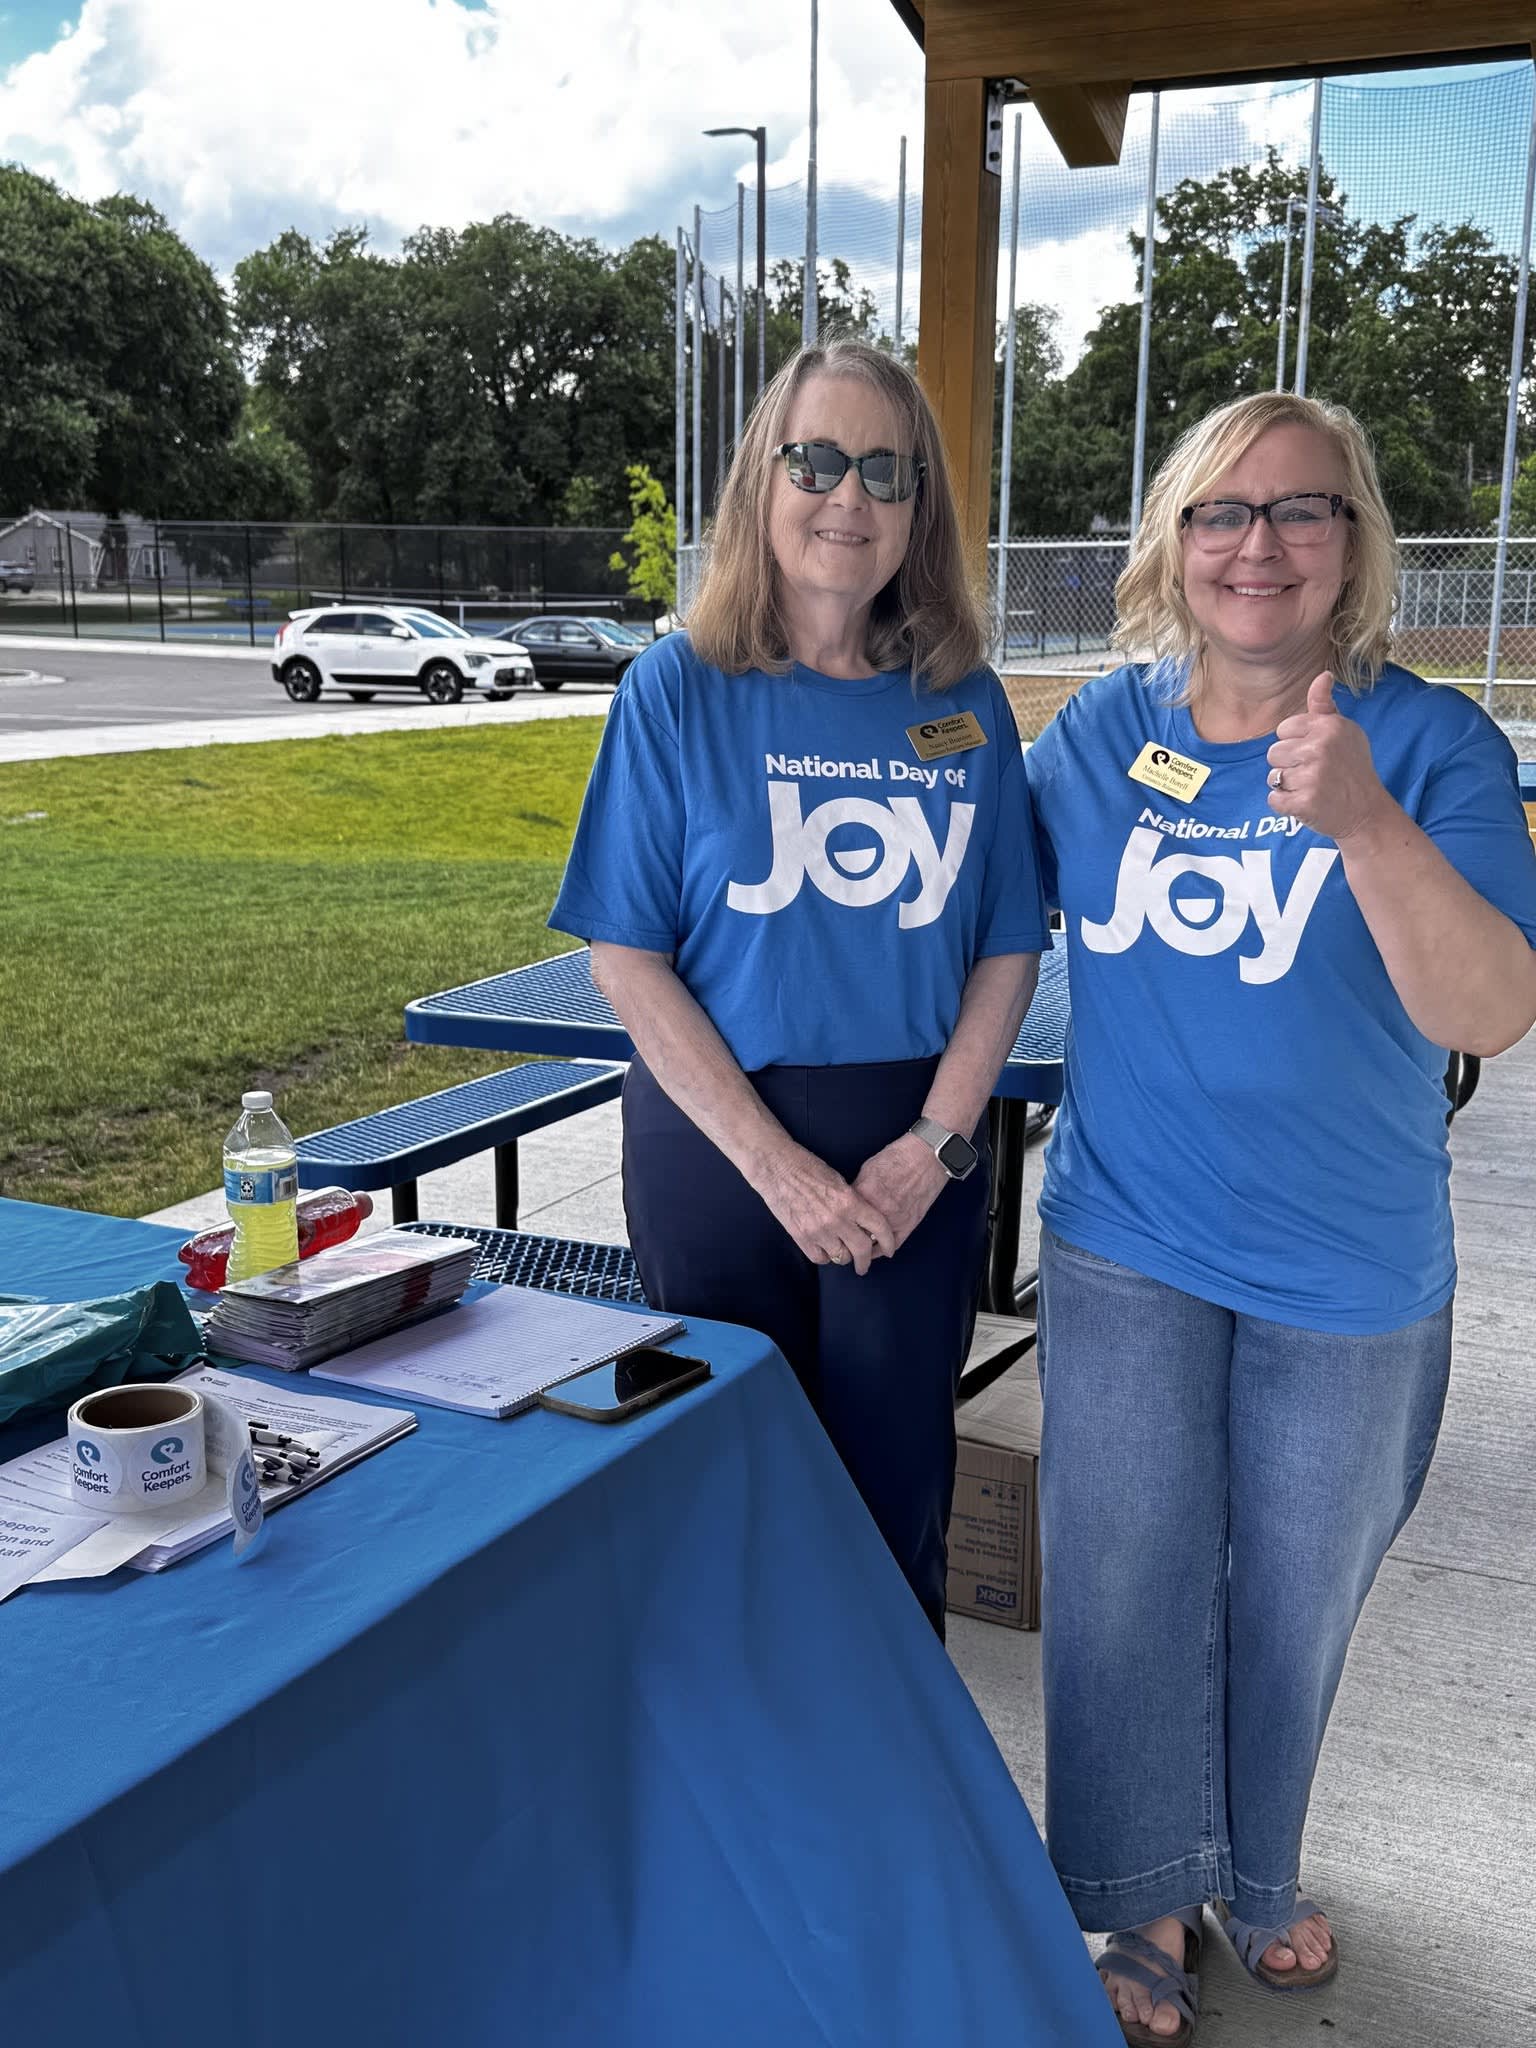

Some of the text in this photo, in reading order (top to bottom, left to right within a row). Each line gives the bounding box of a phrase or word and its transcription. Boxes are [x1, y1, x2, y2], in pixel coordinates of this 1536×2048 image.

[765, 754, 882, 780] National
[889, 760, 938, 789] Day
[1171, 757, 1198, 774] Comfort
[1138, 807, 1304, 839] National Day
[73, 1463, 109, 1484] Comfort
[141, 1460, 191, 1482] Comfort
[20, 1538, 55, 1546] and
[978, 1587, 1014, 1605] TORK
